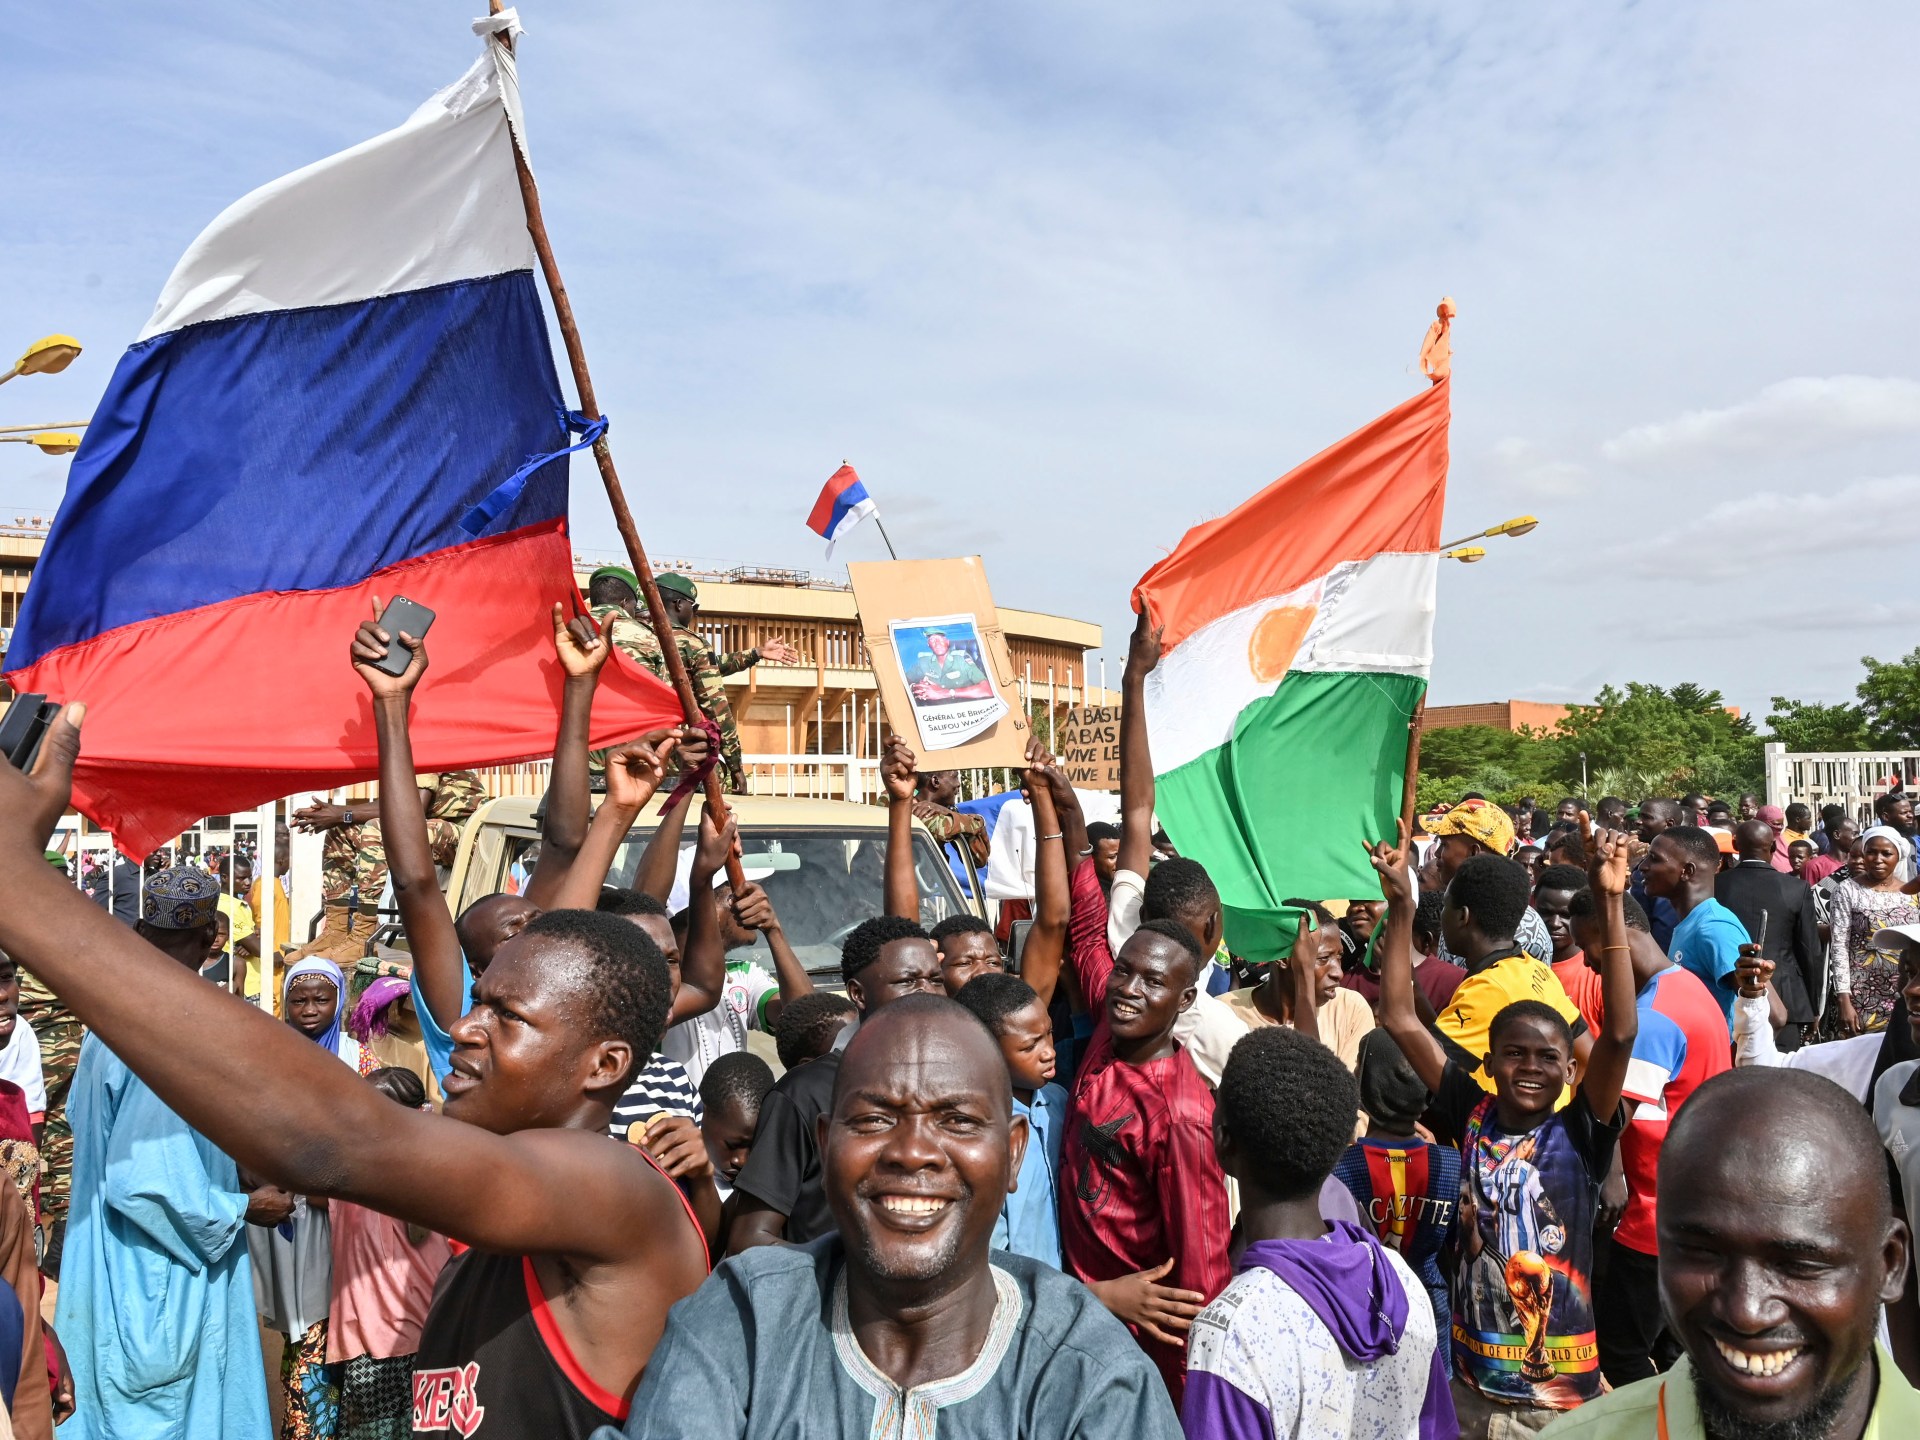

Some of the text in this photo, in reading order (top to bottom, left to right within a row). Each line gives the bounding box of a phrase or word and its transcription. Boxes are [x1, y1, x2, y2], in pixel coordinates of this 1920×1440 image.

[957, 711, 966, 719] DE
[1066, 710, 1079, 727] A
[1083, 707, 1112, 725] BAS
[928, 722, 960, 732] SALIFOU
[1065, 726, 1116, 745] A BAS
[1507, 1347, 1526, 1359] FIF
